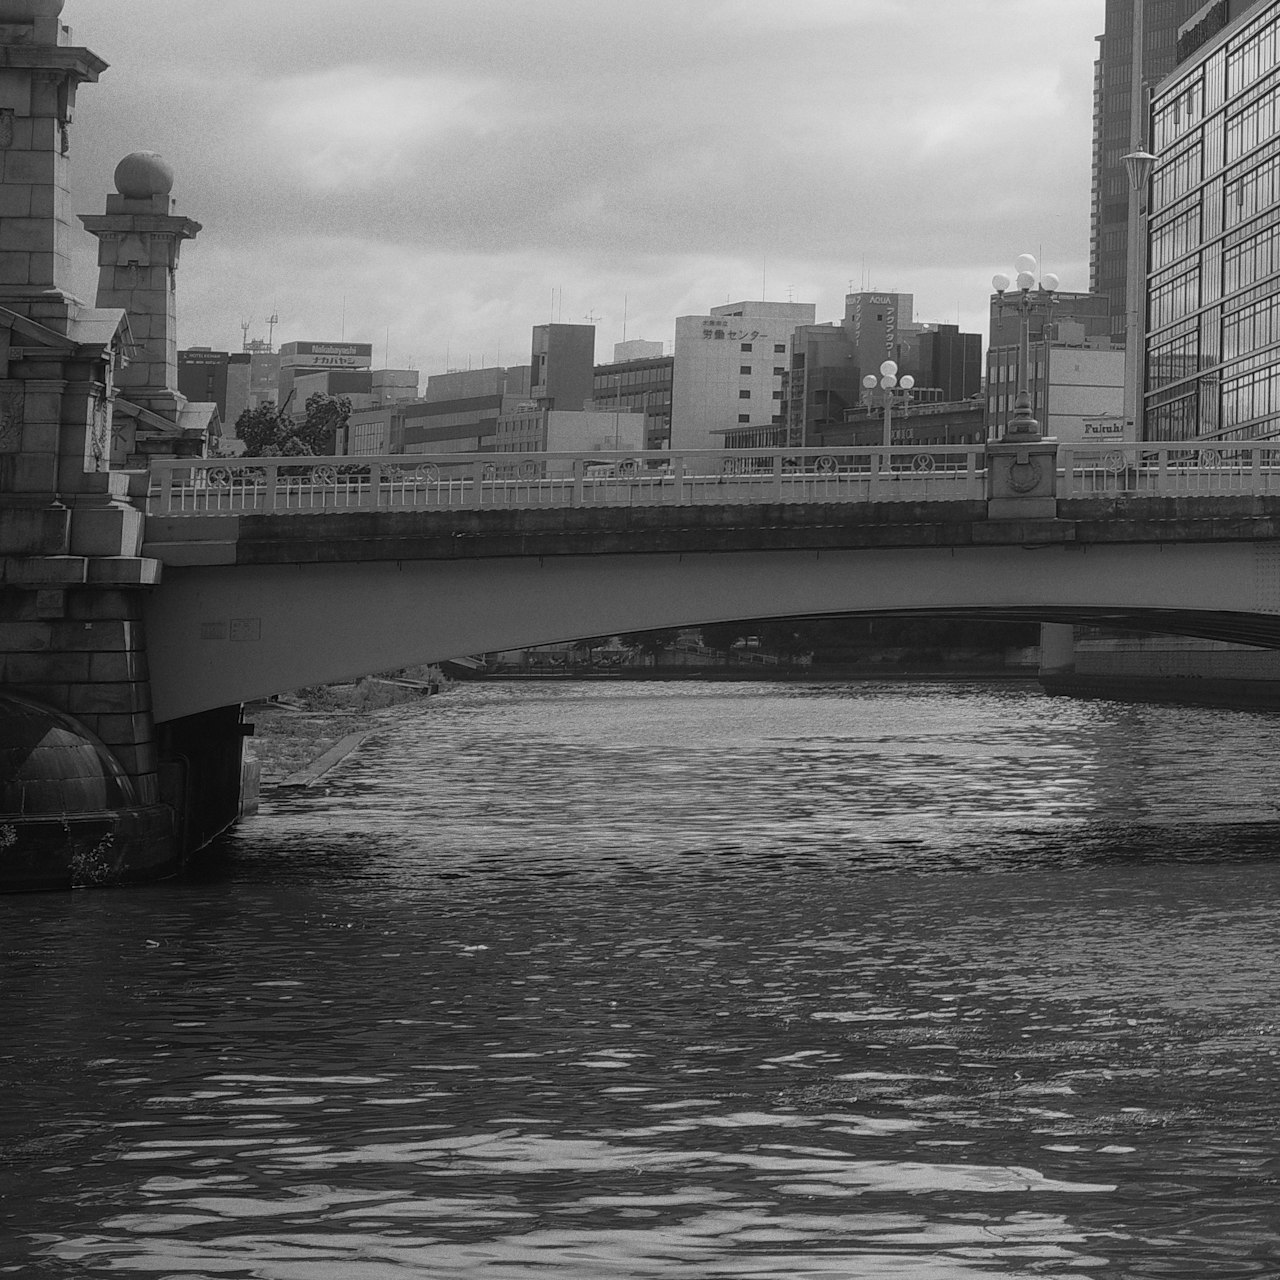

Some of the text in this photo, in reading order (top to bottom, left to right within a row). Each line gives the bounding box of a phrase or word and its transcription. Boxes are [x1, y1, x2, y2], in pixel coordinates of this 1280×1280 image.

[869, 296, 891, 304] AQUA
[703, 329, 768, 341] 労働センター
[313, 356, 355, 365] ナカバヤシ
